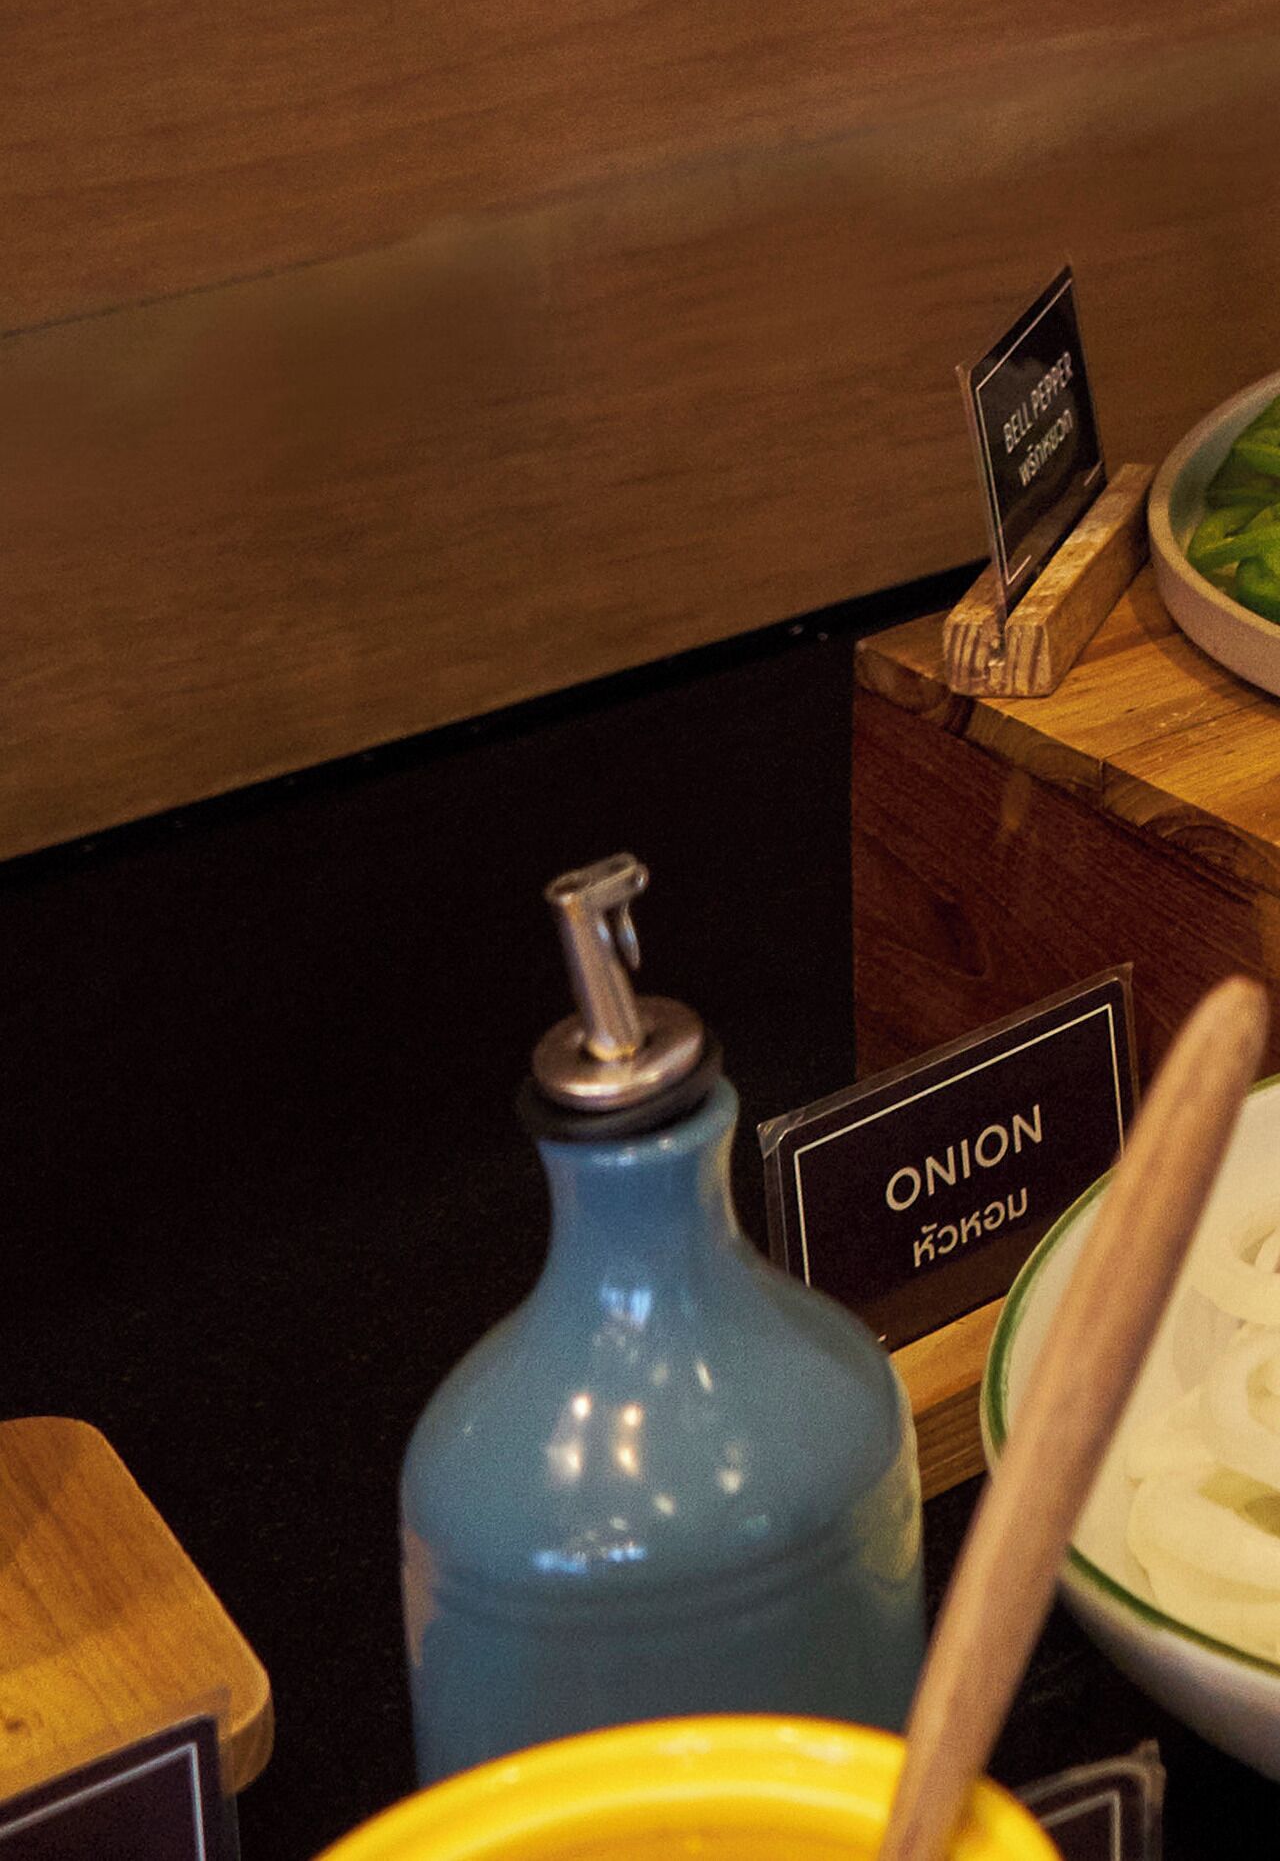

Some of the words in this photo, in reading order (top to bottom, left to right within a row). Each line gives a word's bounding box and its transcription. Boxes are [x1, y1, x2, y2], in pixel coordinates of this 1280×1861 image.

[1003, 402, 1033, 454] BELL
[1030, 350, 1074, 421] PEPPER
[884, 1103, 1044, 1212] ONION
[913, 1187, 1029, 1268] หัวหอม
